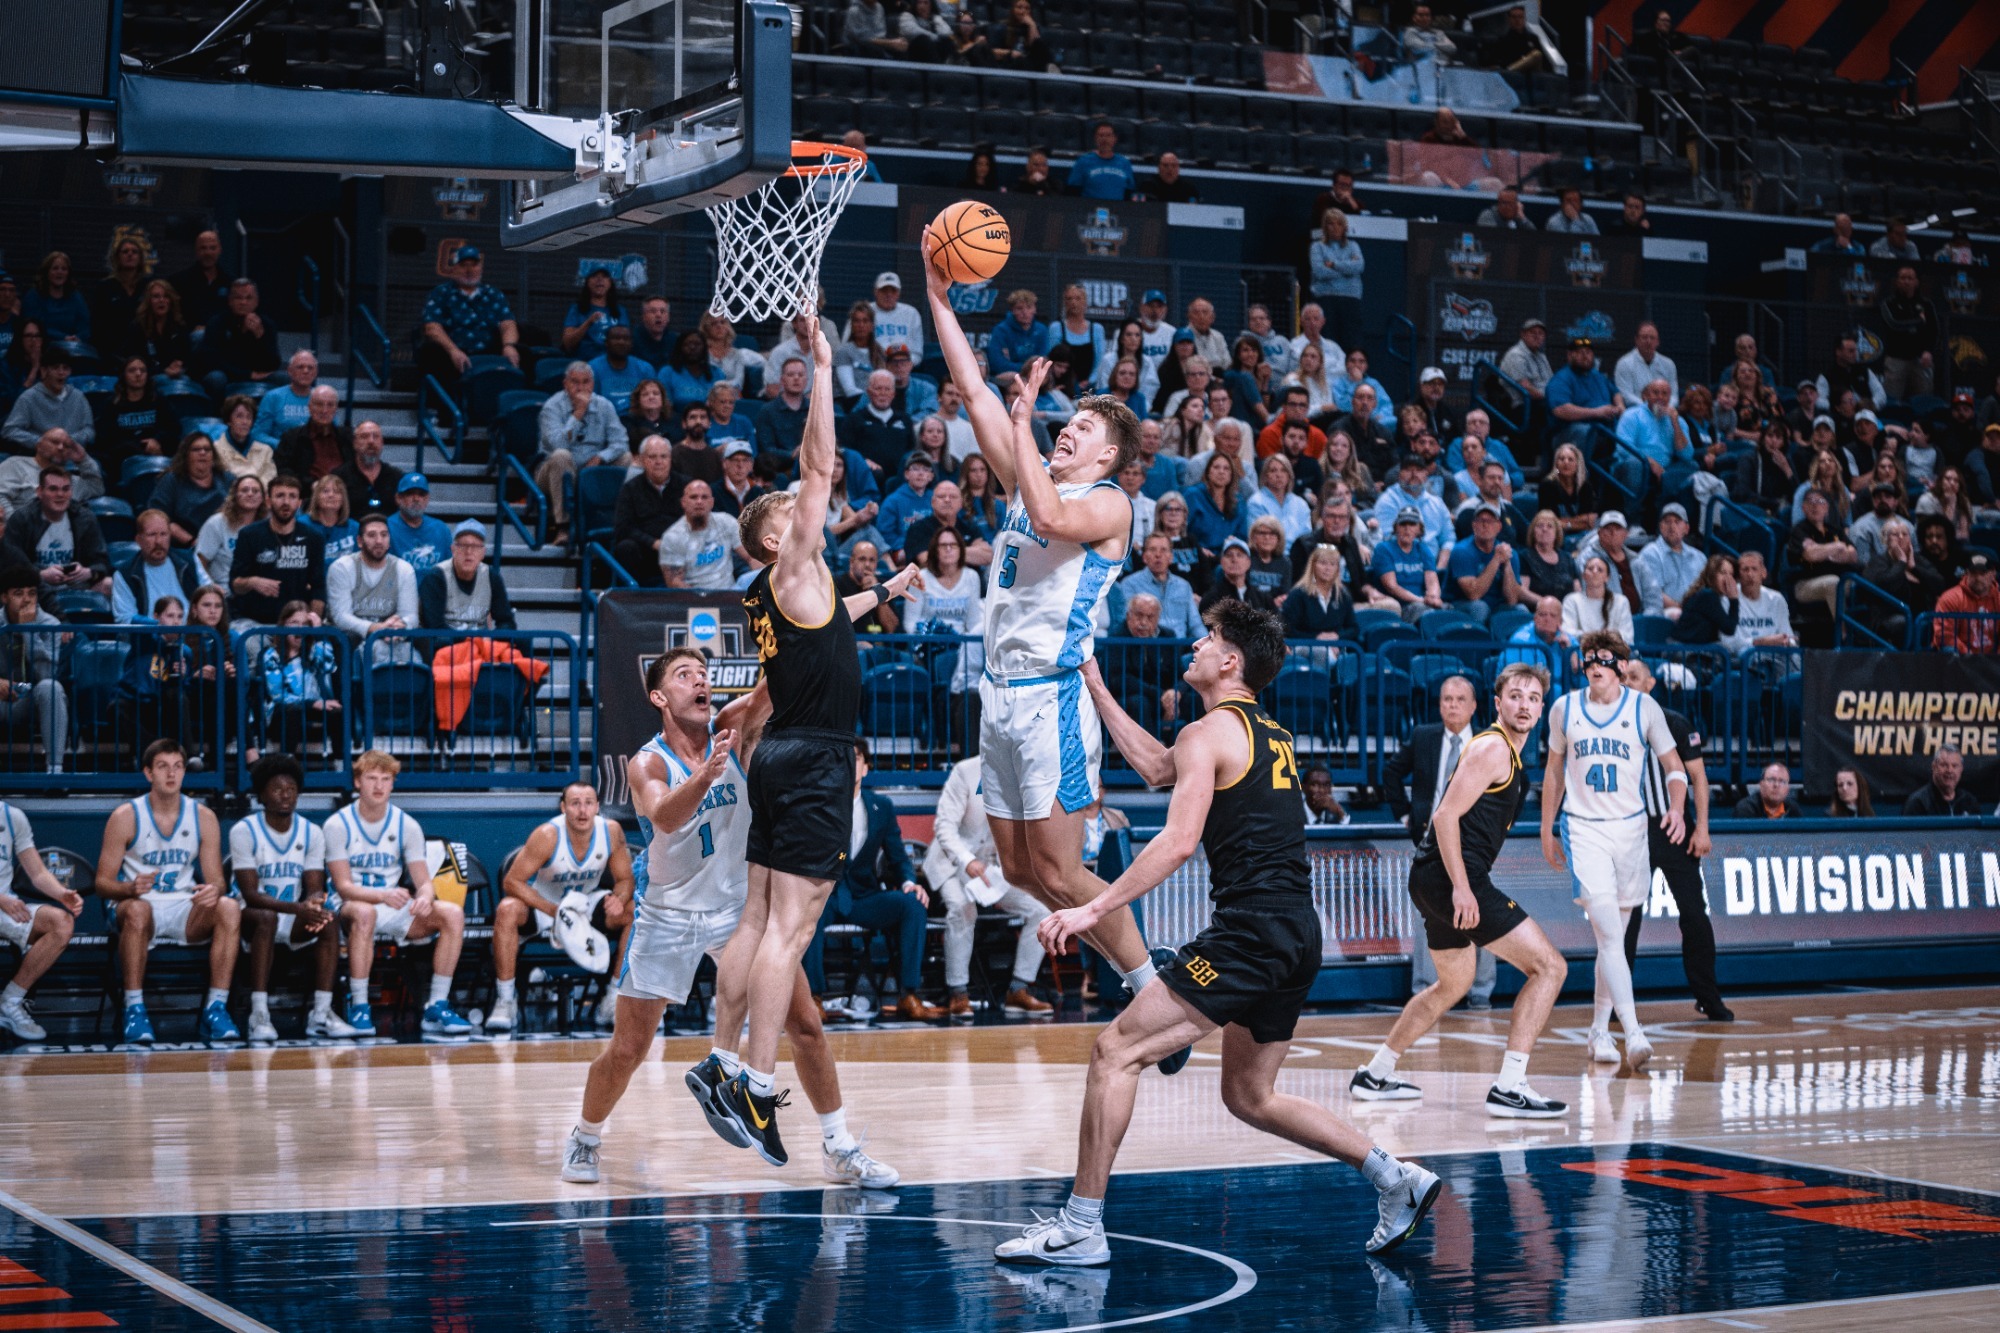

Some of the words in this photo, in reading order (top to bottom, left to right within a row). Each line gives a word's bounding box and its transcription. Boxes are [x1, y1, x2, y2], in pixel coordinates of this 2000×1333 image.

[284, 404, 310, 418] SHAR
[276, 558, 309, 569] SHARKS
[281, 545, 307, 559] NSU
[998, 544, 1020, 589] 5
[693, 624, 717, 635] NCAA
[709, 665, 758, 687] EIGHT
[1835, 690, 2000, 723] CHAMPION
[1573, 737, 1631, 761] SHARKS
[1854, 724, 1917, 757] WIN
[1922, 725, 1999, 757] HERE
[1586, 763, 1618, 793] 41
[698, 822, 715, 859] 1
[142, 849, 191, 866] SHARKS
[350, 851, 397, 869] SHARKS
[257, 862, 305, 880] SHARKS
[1723, 853, 1927, 916] DIVISION
[1939, 852, 1970, 909] II
[1186, 956, 1220, 987] BH
